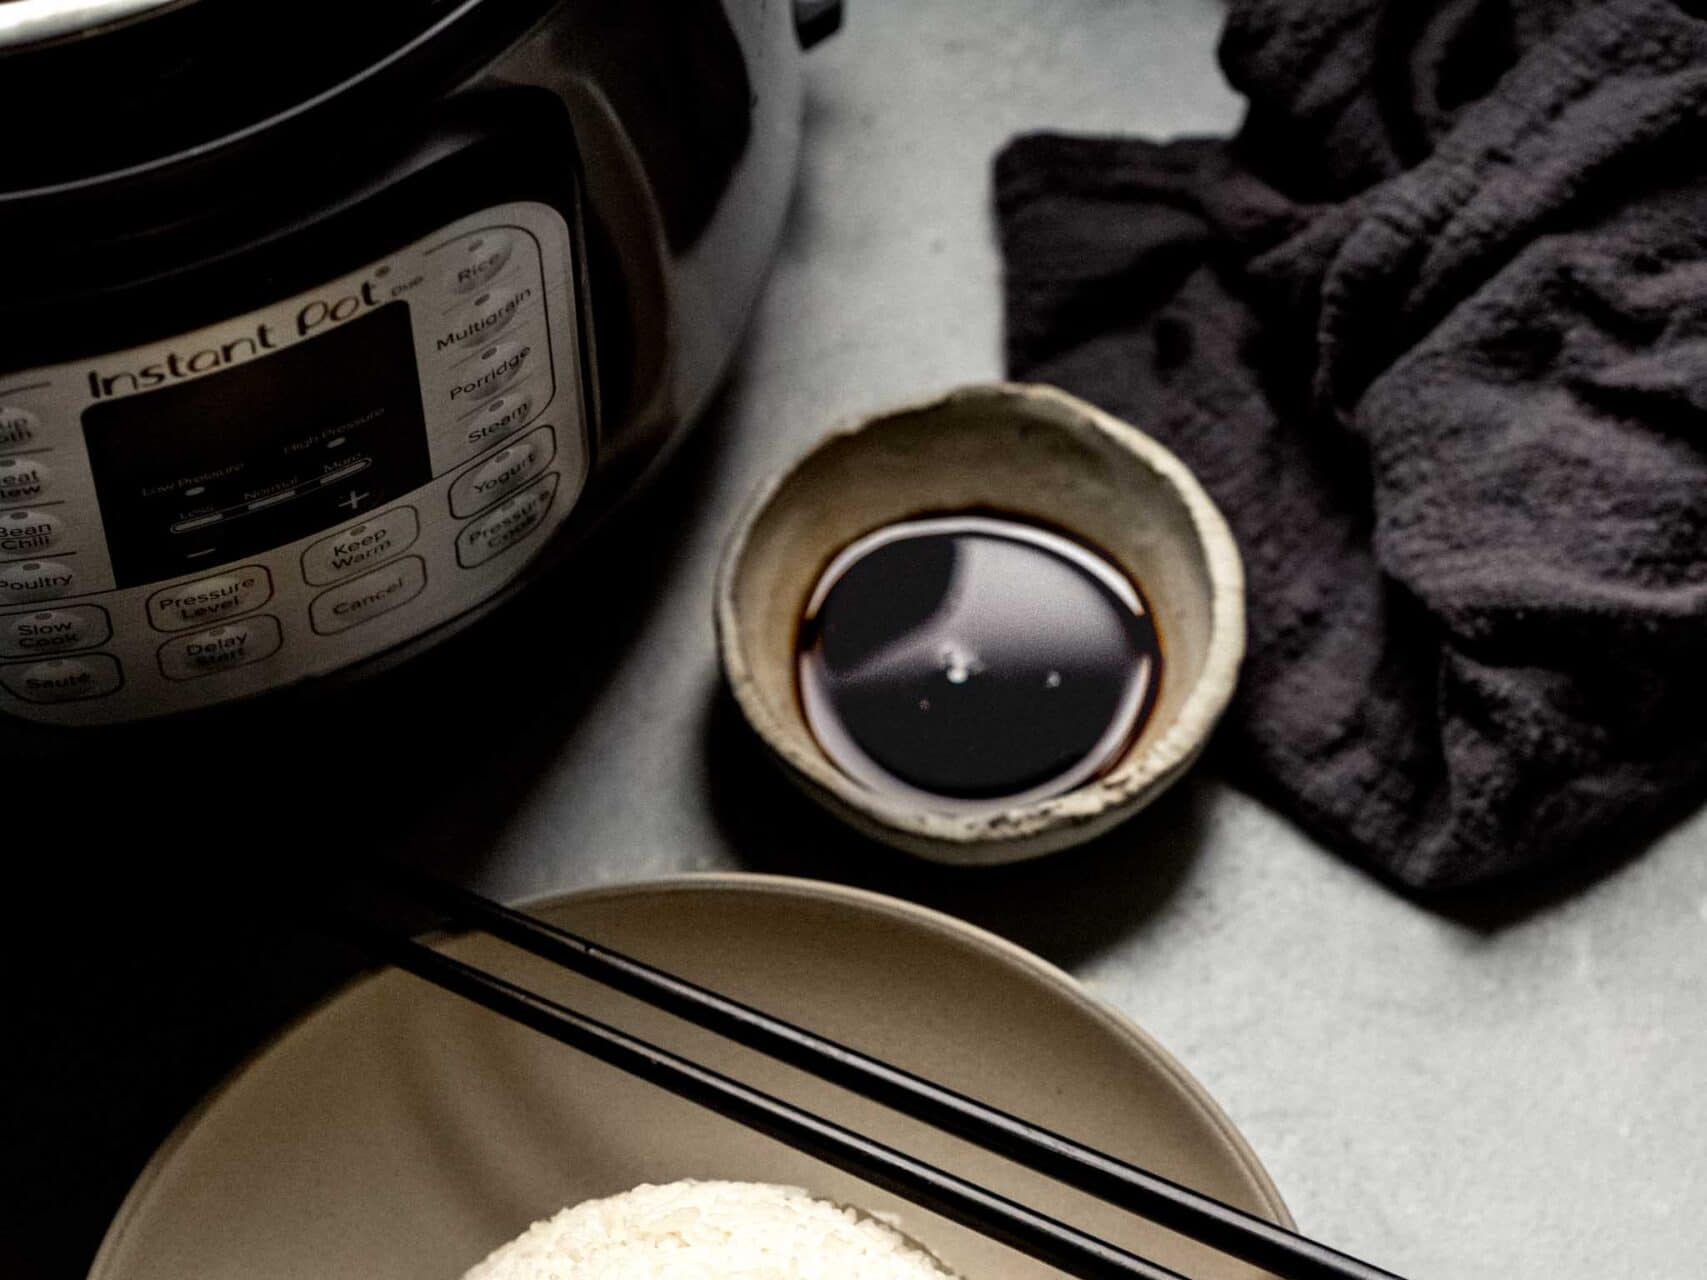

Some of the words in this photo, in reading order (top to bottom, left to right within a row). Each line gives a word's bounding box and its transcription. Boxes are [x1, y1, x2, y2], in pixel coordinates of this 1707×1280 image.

[457, 251, 502, 283] Rice
[437, 288, 531, 351] Multigrain
[88, 326, 275, 398] Instant
[450, 346, 531, 401] Porridge
[468, 402, 528, 444] Steam
[473, 452, 536, 494] Yogurt
[332, 539, 393, 570] Warm
[334, 527, 388, 556] Keep
[160, 578, 256, 611] Pressure
[181, 595, 240, 620] Level
[334, 577, 404, 615] Cancel
[18, 622, 72, 636] Slow
[19, 634, 79, 648] Cook
[187, 633, 248, 656] Delay
